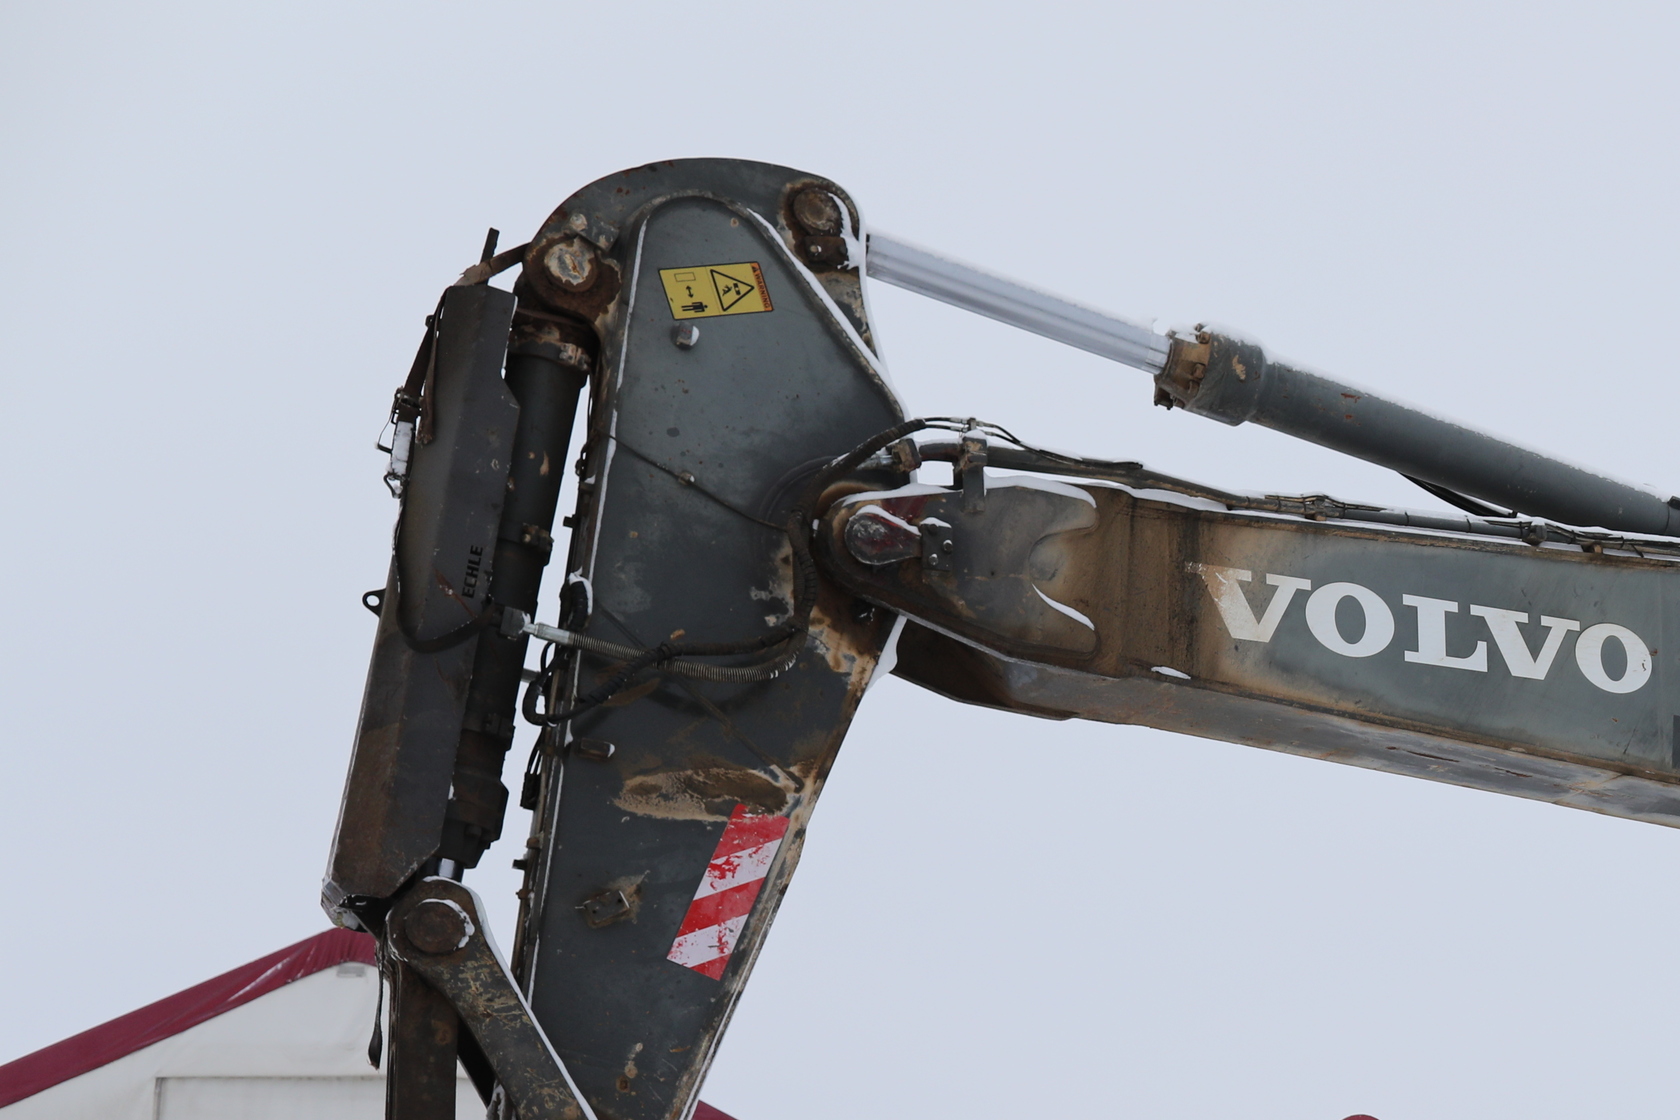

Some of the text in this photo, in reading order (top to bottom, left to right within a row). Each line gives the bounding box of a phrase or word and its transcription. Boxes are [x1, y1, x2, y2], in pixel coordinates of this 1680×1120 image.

[754, 272, 770, 309] WARNING
[462, 545, 483, 599] ECHLE
[1199, 563, 1652, 694] VOLVO
